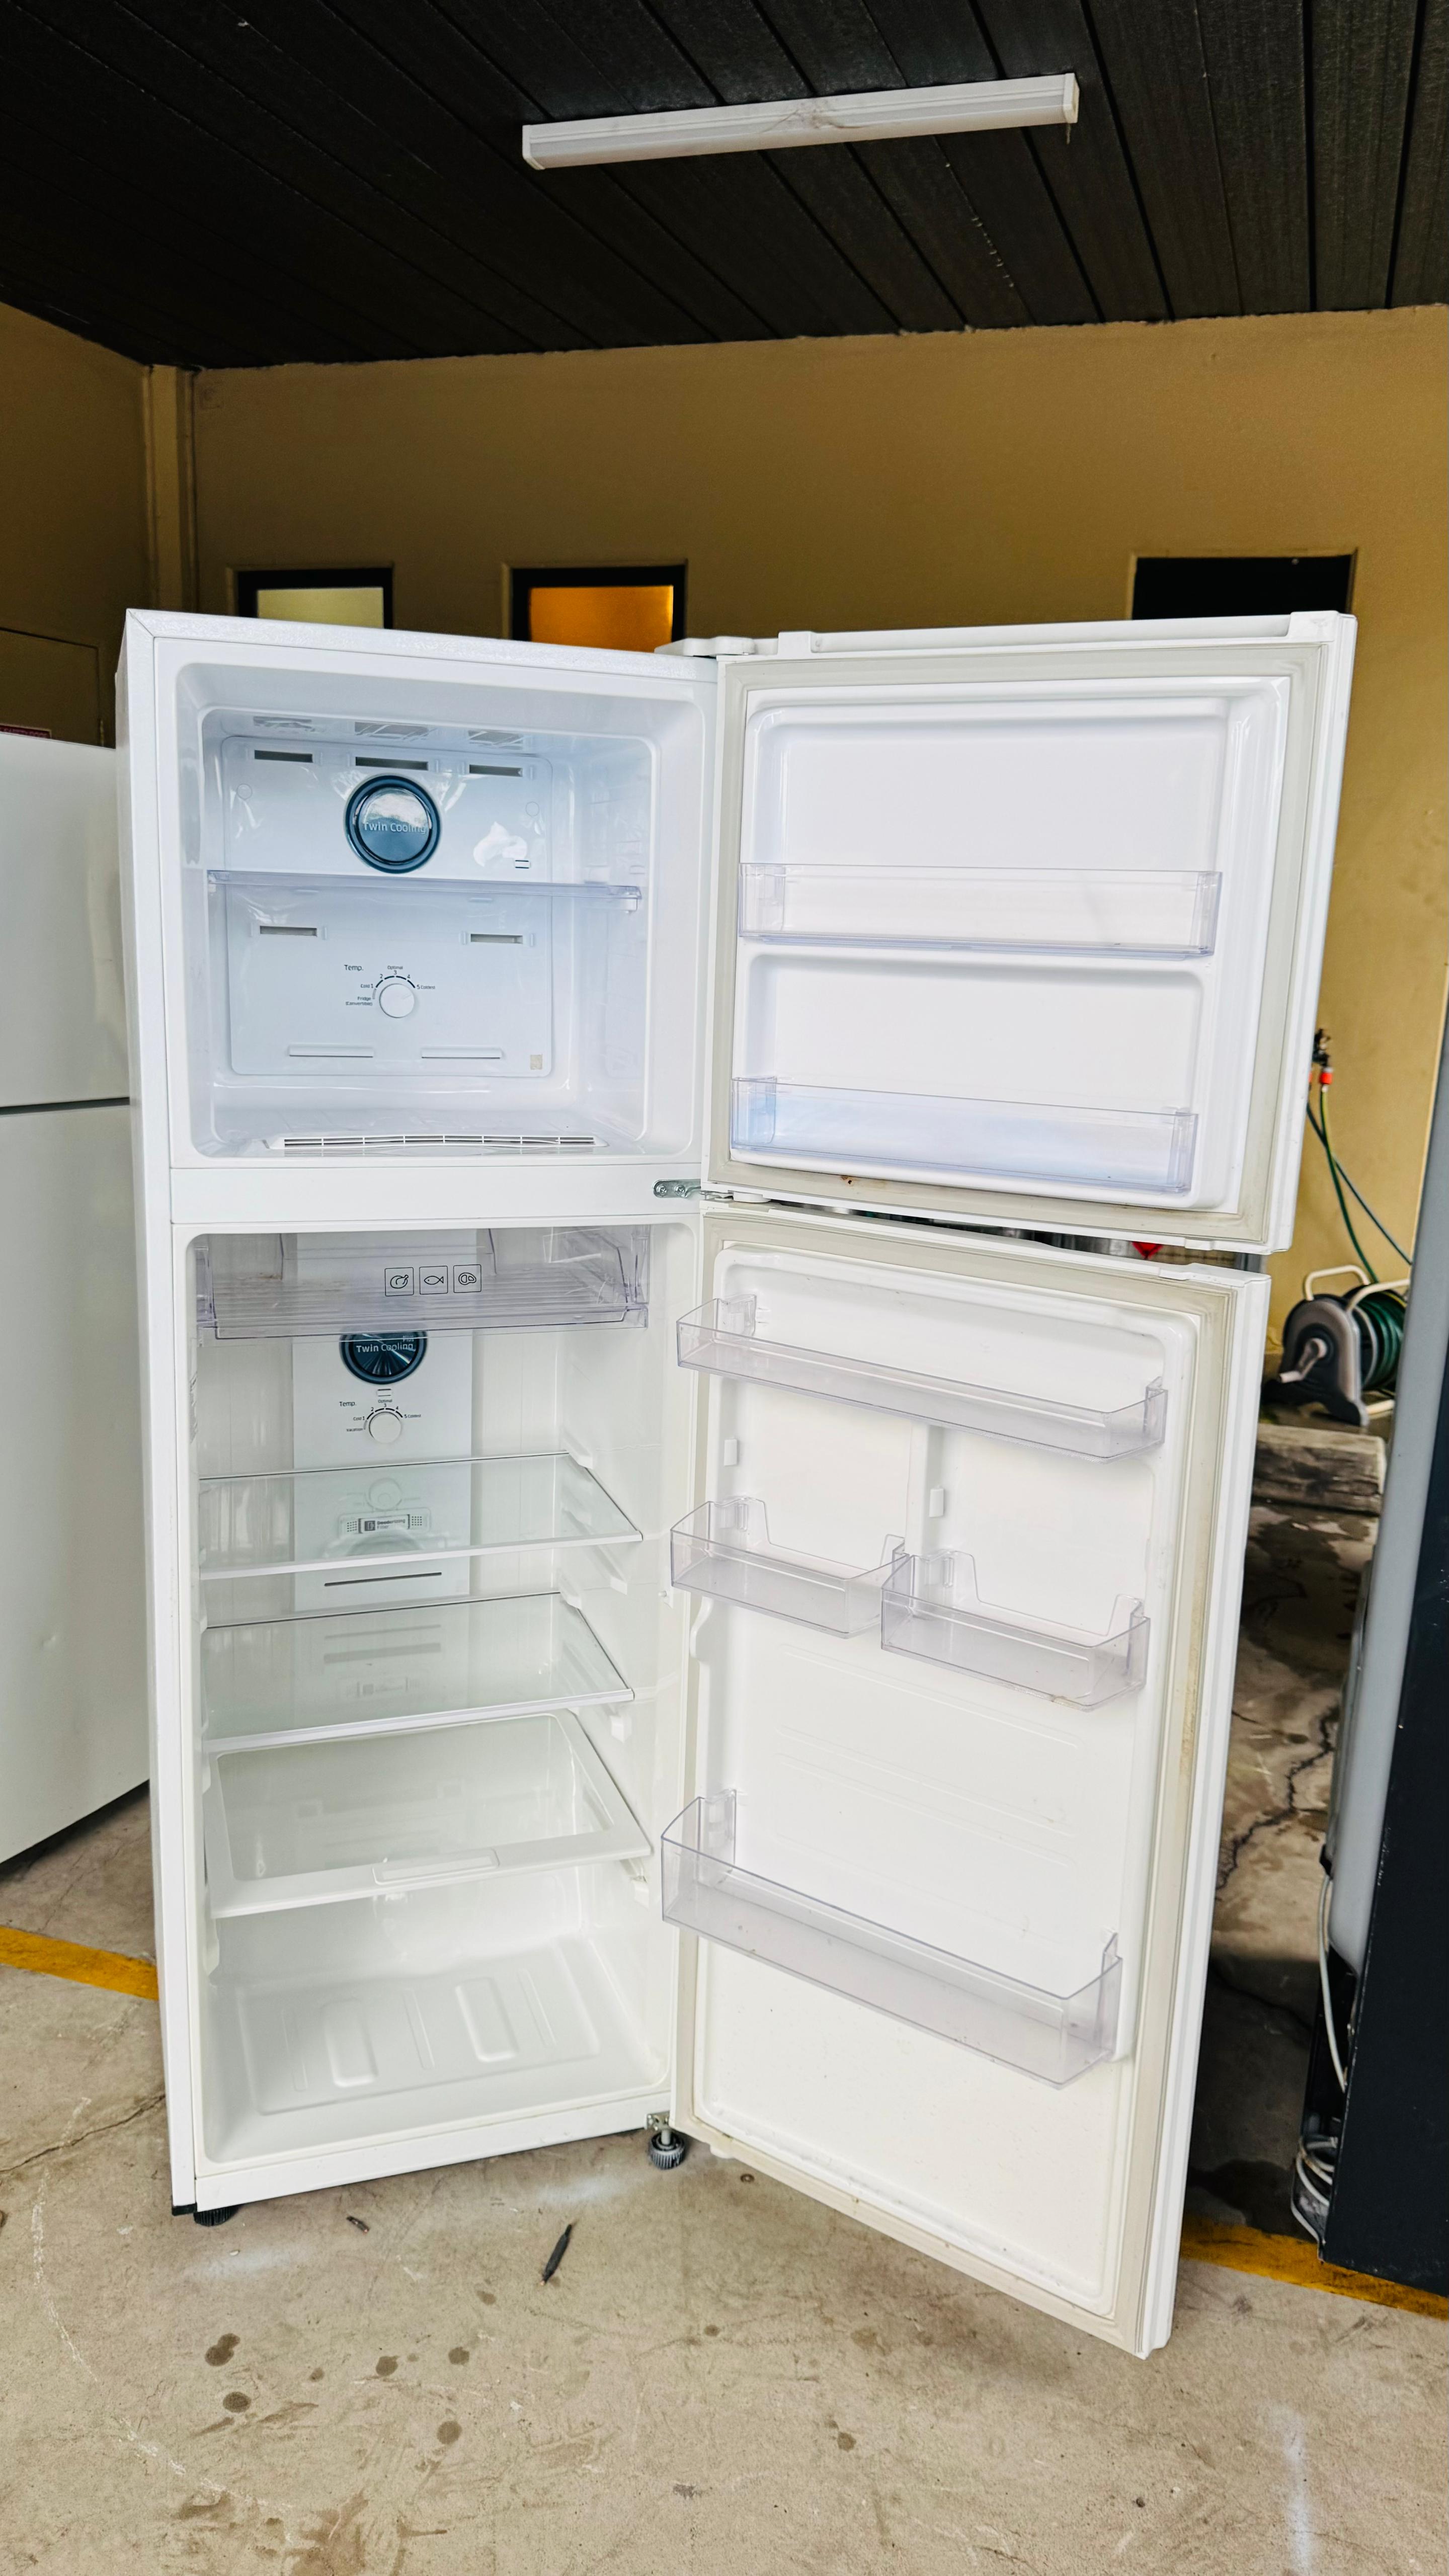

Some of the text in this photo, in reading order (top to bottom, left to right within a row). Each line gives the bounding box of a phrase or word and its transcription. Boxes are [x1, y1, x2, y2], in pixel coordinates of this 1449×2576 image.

[364, 822, 427, 834] Twin Cooling
[356, 1342, 414, 1352] Twin Cooling
